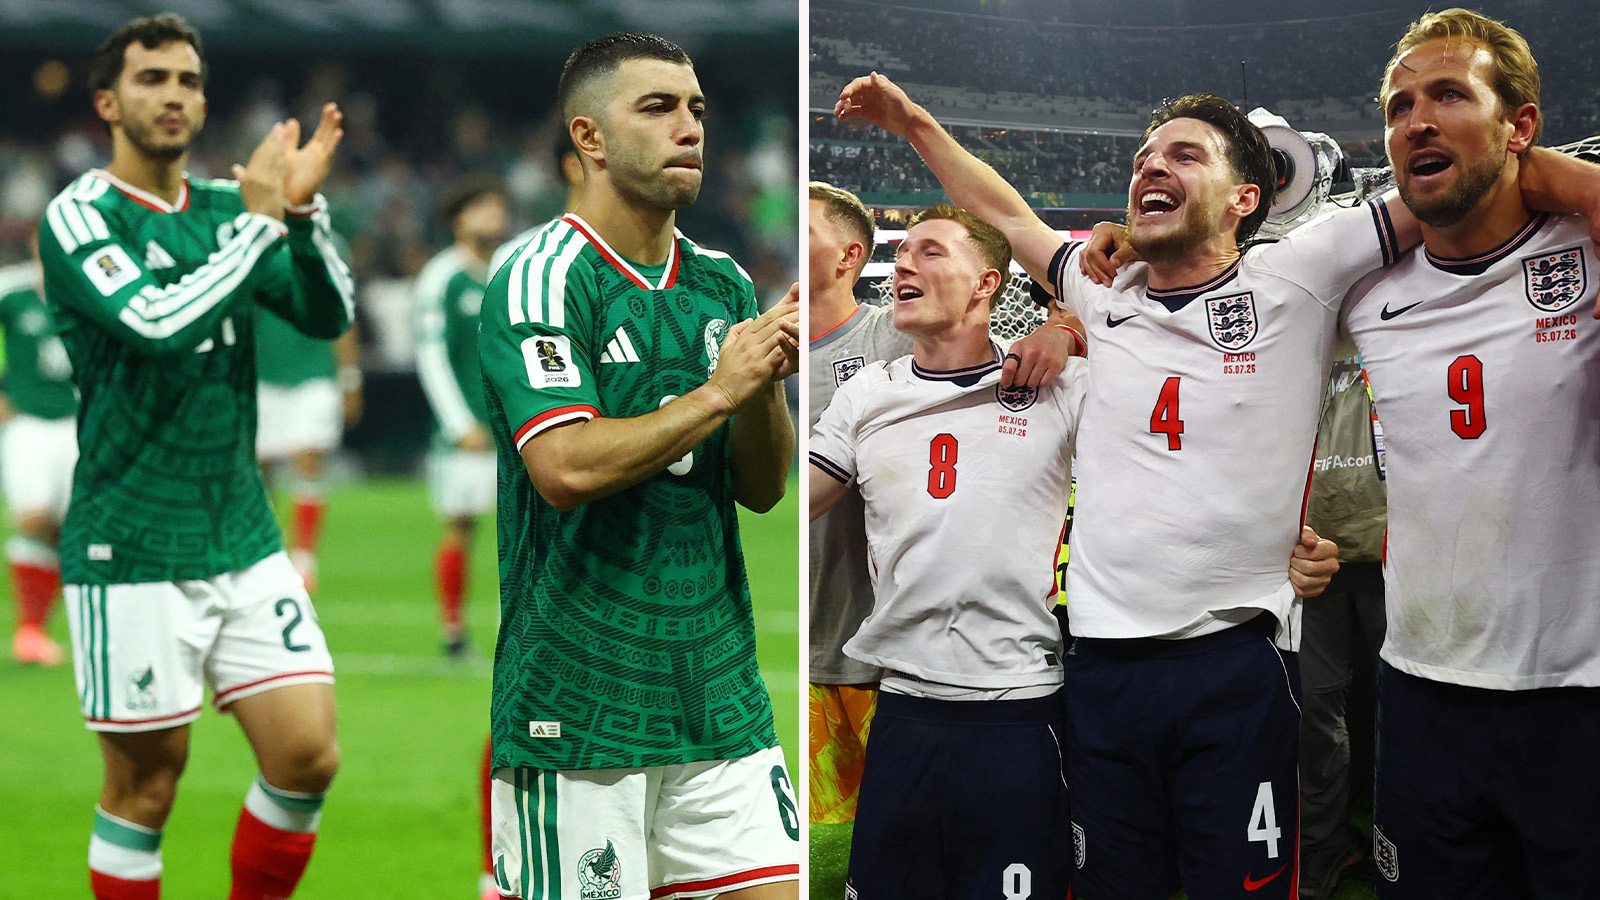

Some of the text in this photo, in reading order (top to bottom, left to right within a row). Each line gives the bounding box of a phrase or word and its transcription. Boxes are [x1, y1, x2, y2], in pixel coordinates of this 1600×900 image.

[1536, 314, 1577, 329] MEXICO
[1536, 329, 1576, 343] 05.07.26
[1224, 352, 1256, 363] MEXICO
[1224, 364, 1256, 374] 05.07.26
[1150, 376, 1184, 451] 4
[1447, 354, 1487, 439] 9
[998, 425, 1027, 437] 05.07.26
[999, 415, 1028, 427] MEXICO
[927, 433, 958, 499] 8
[275, 598, 311, 652] 2
[769, 765, 800, 842] 6
[1247, 781, 1282, 859] 4
